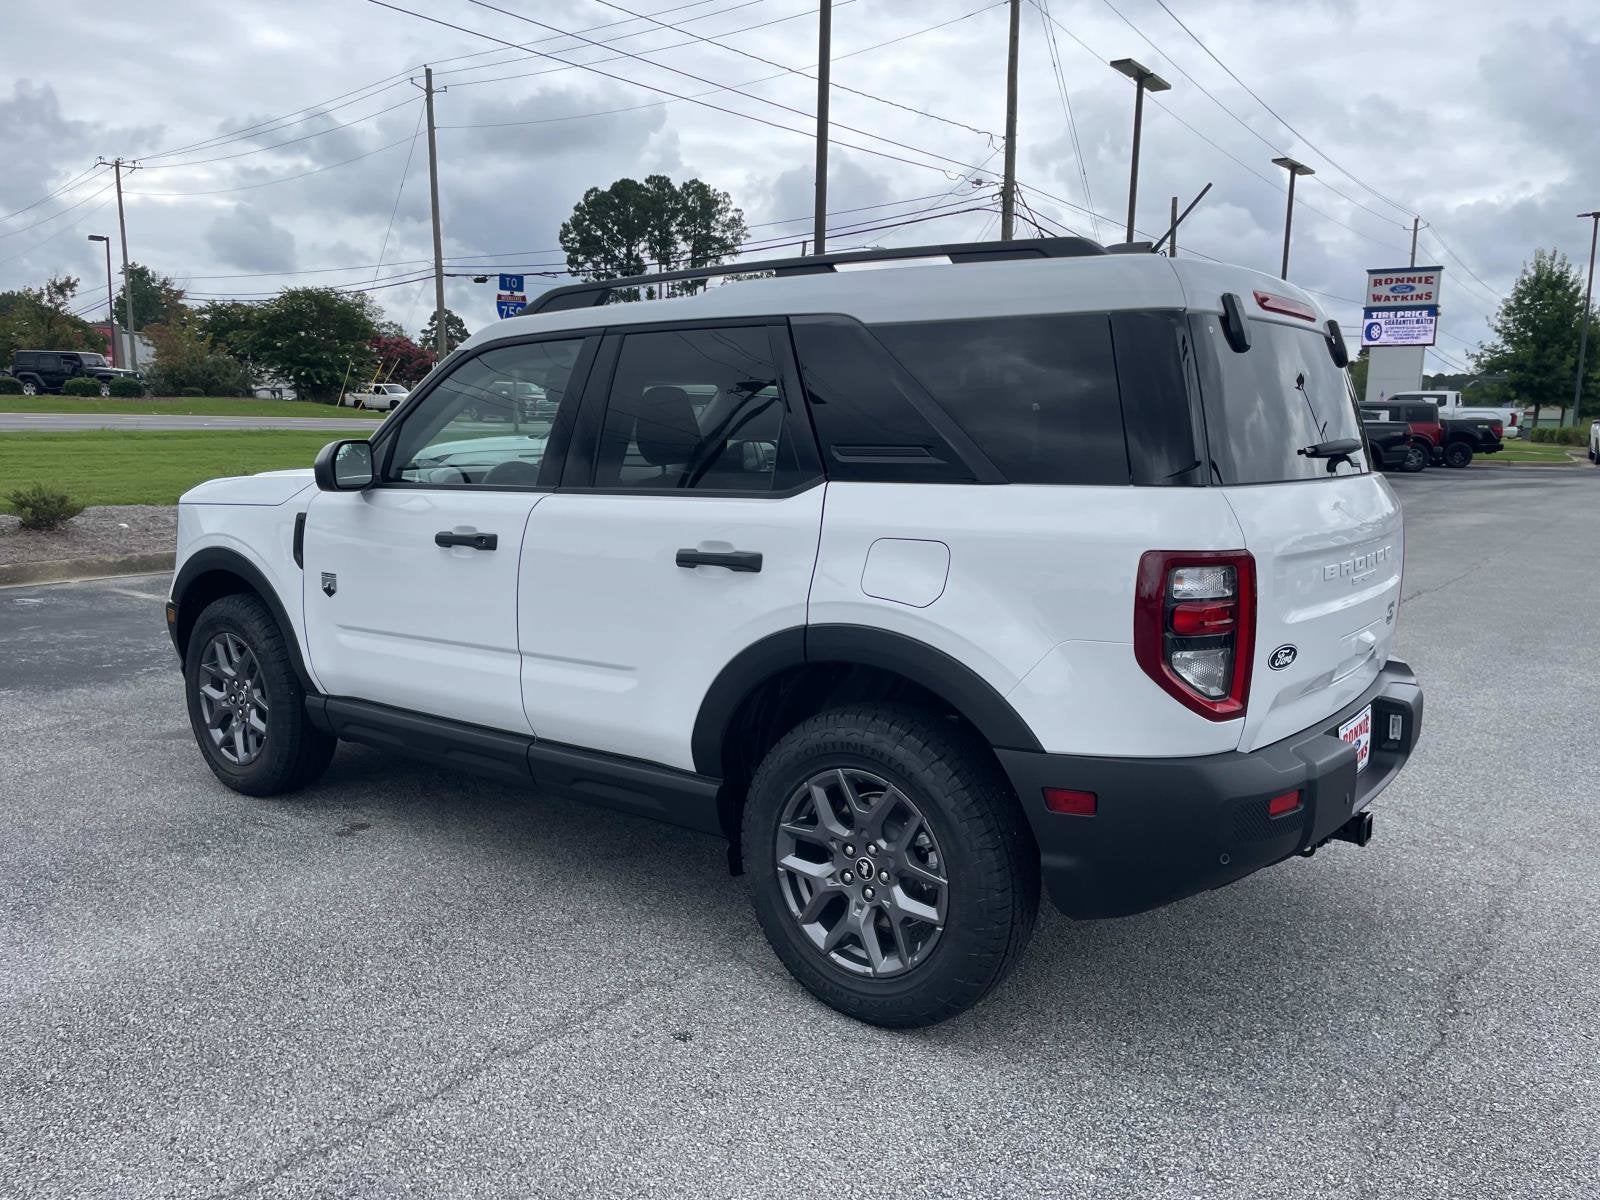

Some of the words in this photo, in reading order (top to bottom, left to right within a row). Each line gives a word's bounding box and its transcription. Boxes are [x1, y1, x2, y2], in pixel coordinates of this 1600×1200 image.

[505, 277, 518, 288] TO
[1373, 276, 1434, 287] RONNIE
[1372, 291, 1433, 302] WATKINS
[1371, 311, 1396, 319] TIRE
[1397, 310, 1429, 318] PRICE
[1274, 649, 1295, 667] Ford
